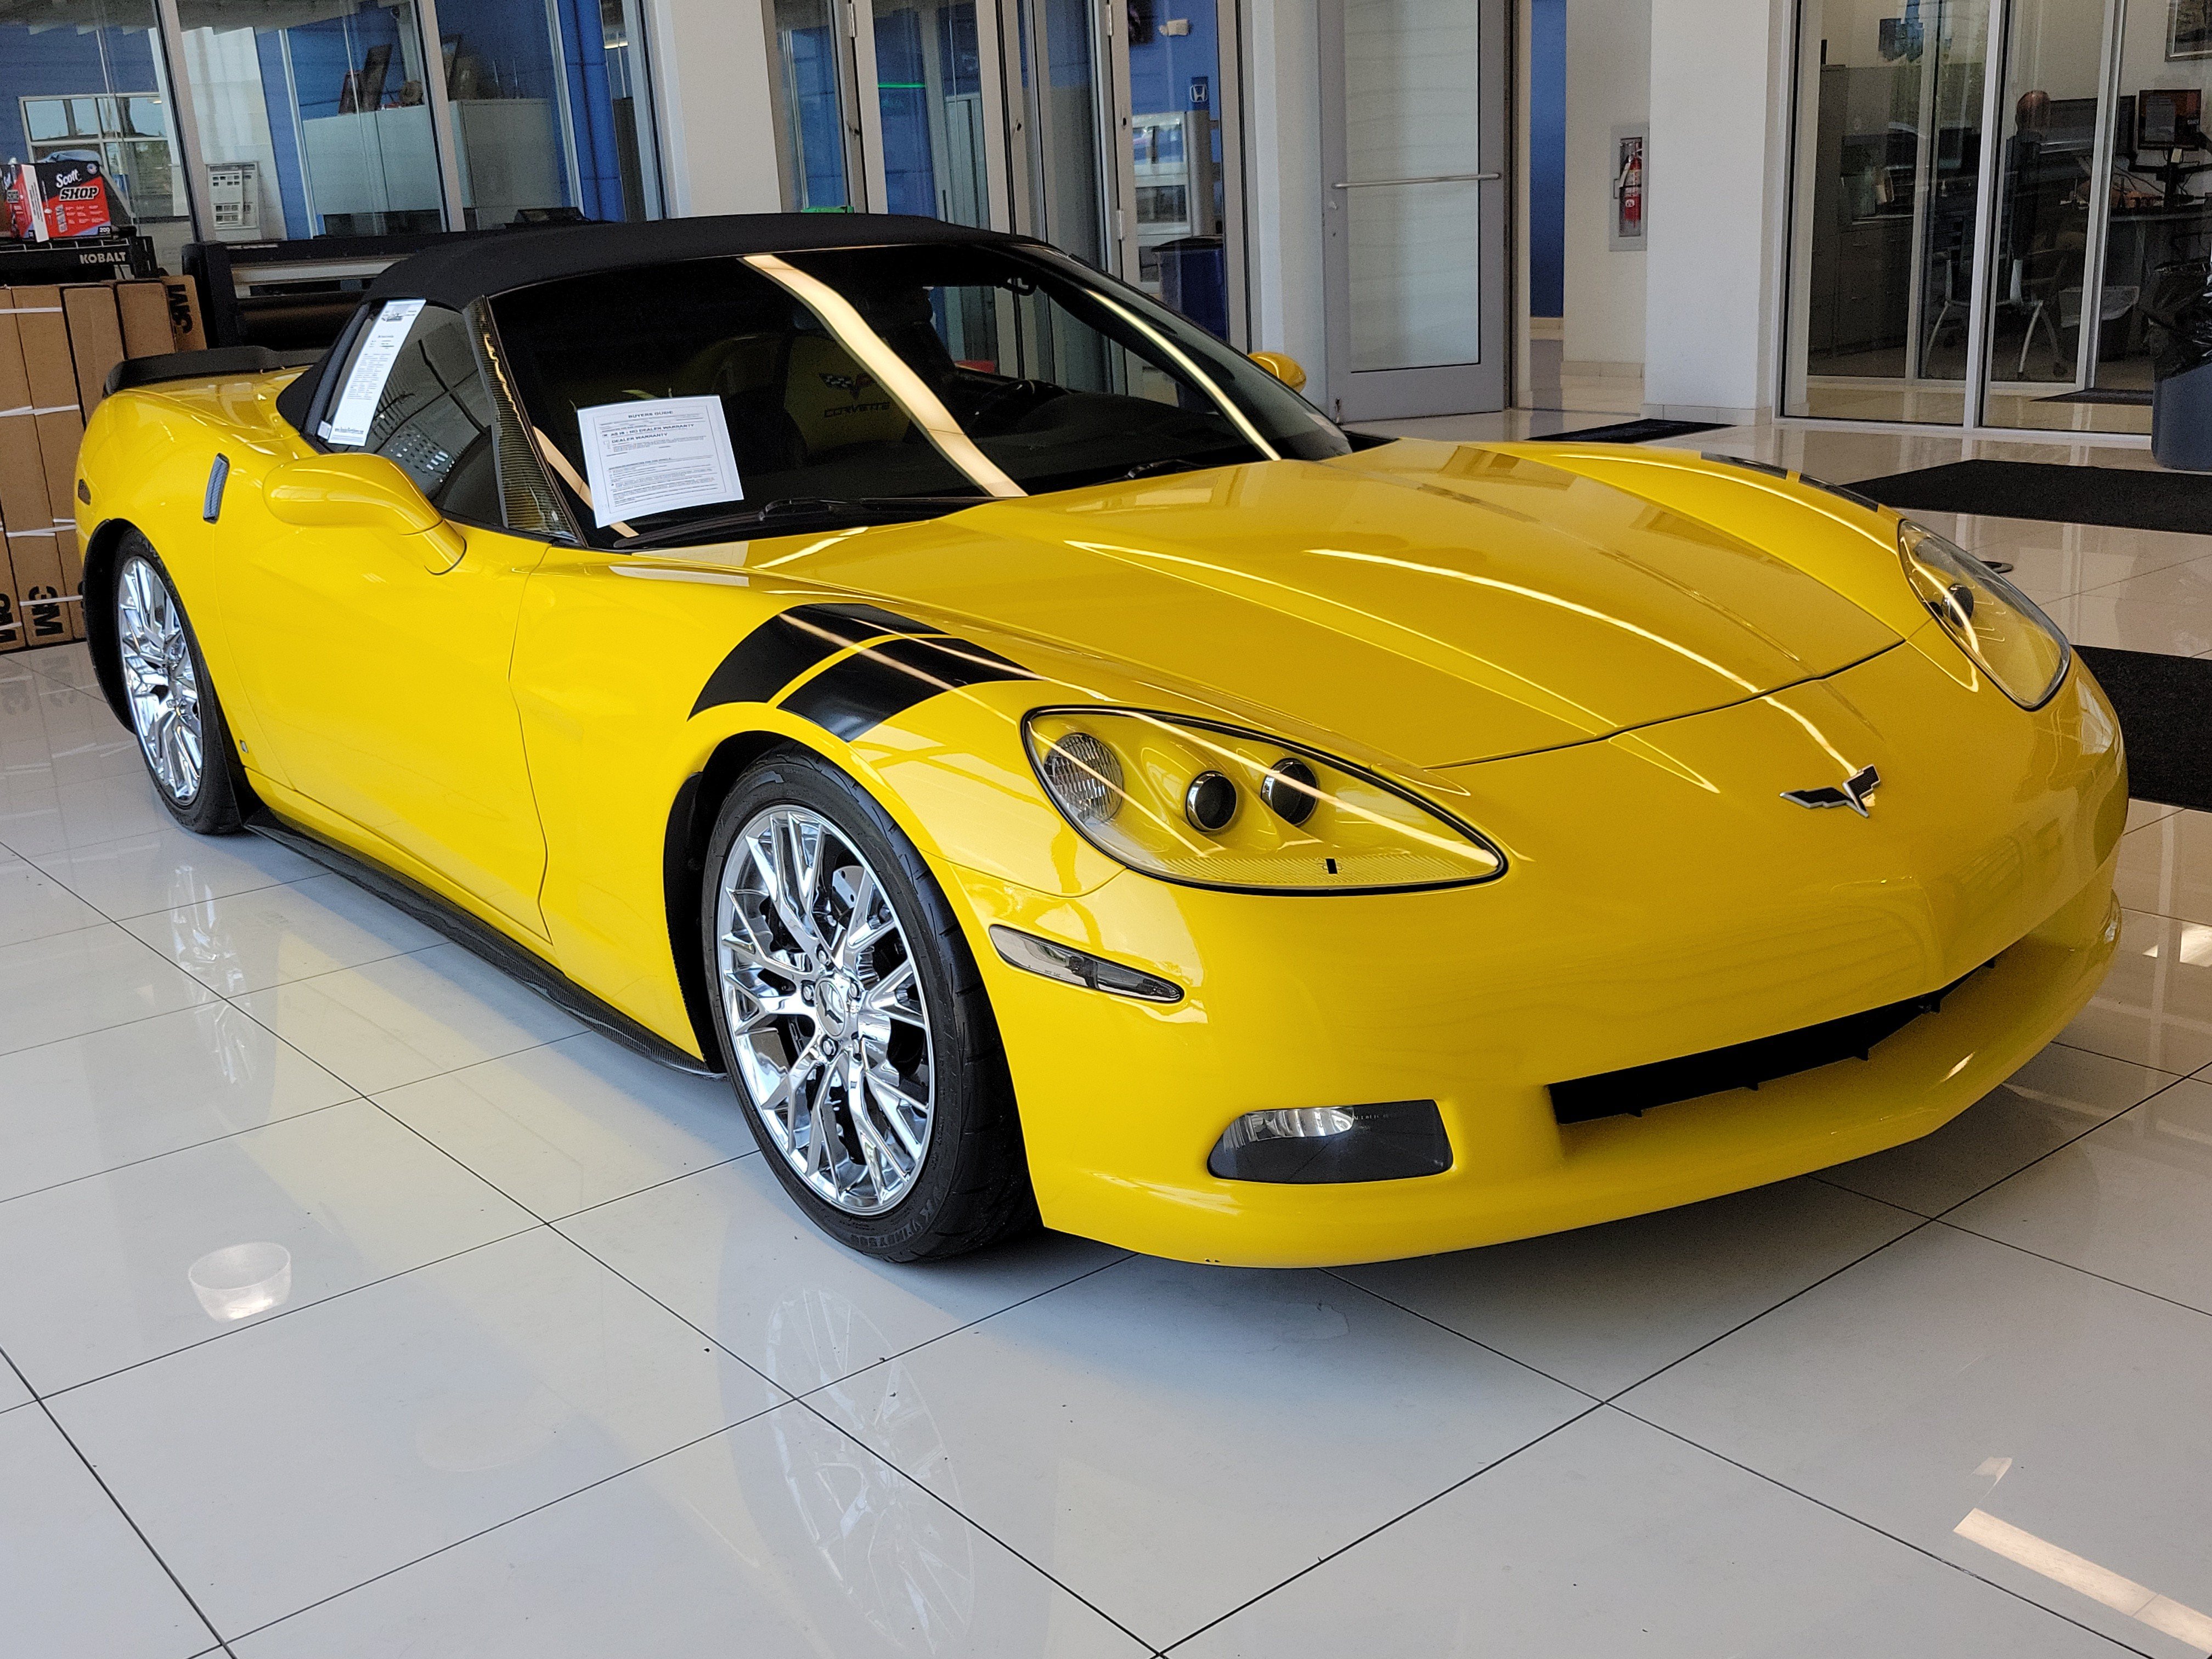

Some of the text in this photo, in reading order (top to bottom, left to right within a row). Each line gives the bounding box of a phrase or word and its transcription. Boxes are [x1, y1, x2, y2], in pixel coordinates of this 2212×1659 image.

[56, 168, 80, 188] Scott
[60, 187, 98, 200] SHOP
[79, 252, 126, 264] KOBALT
[29, 585, 64, 637] 3M
